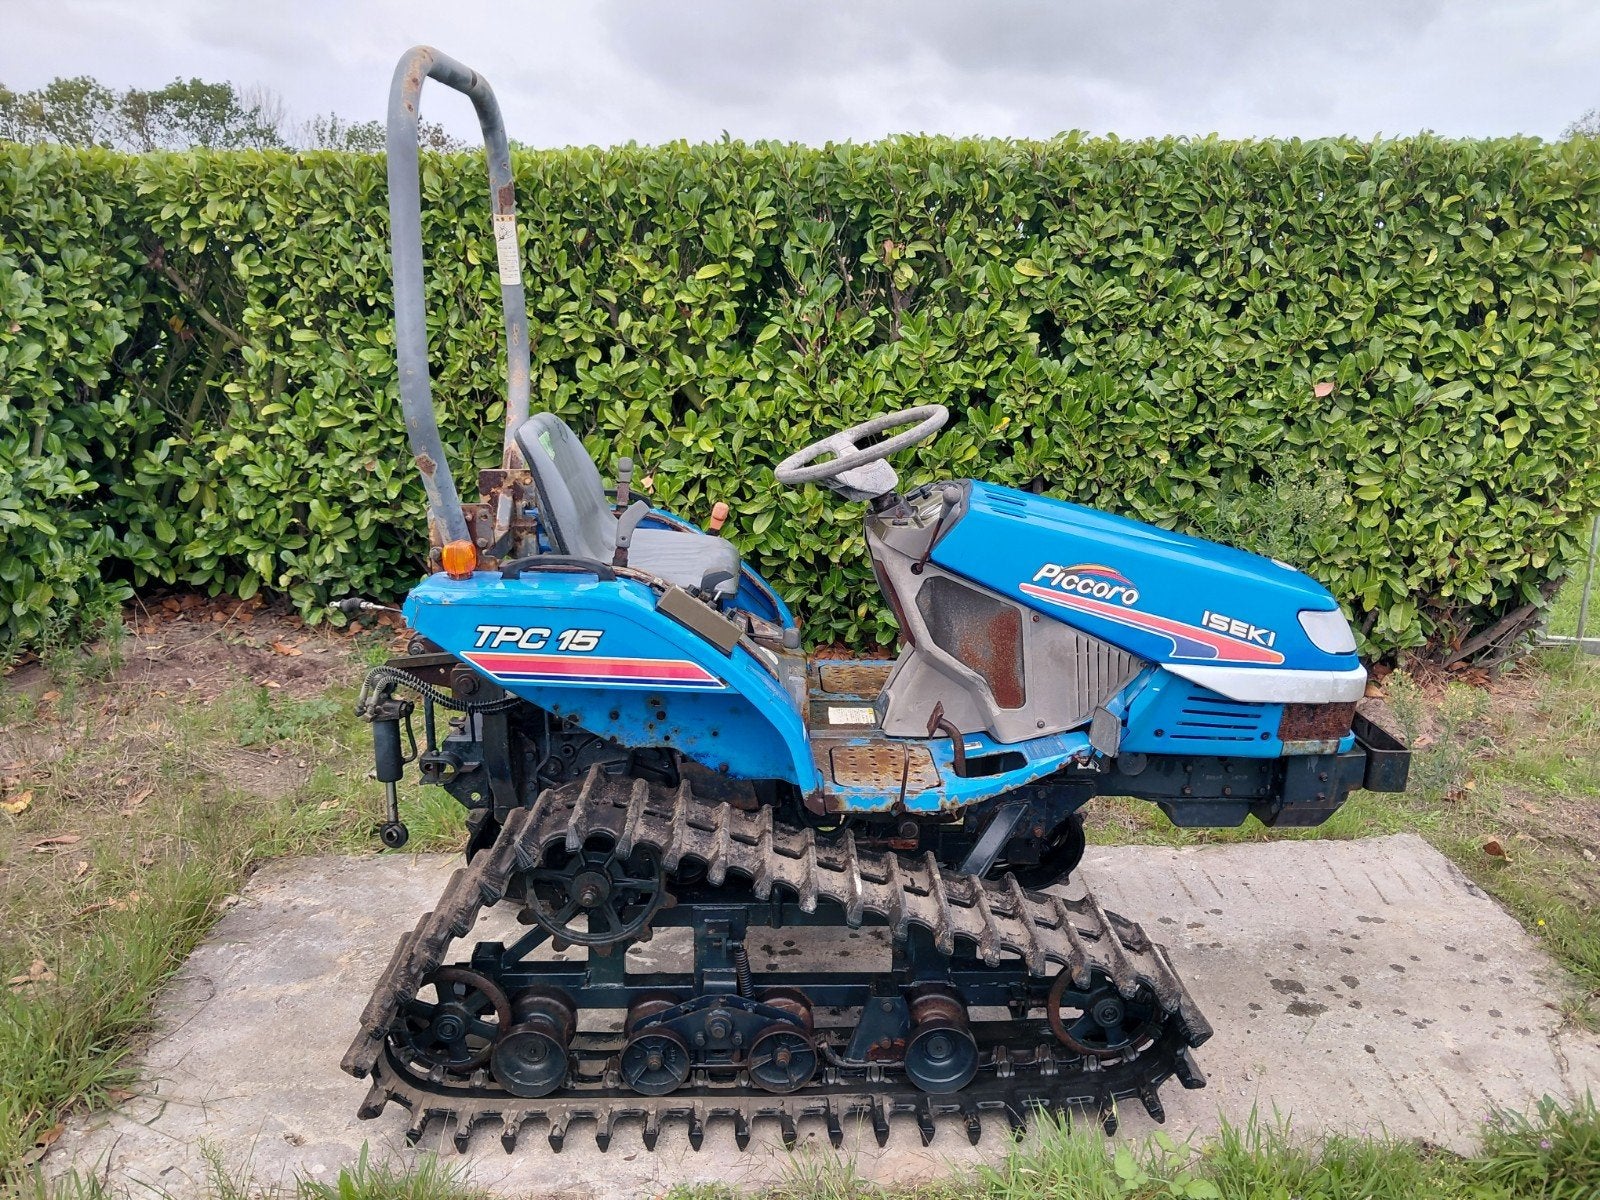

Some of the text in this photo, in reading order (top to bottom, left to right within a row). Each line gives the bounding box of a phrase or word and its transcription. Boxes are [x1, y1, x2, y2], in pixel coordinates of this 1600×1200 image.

[1033, 563, 1139, 605] Piccoro
[475, 625, 604, 652] TPC 15
[1201, 610, 1276, 647] ISEKI
